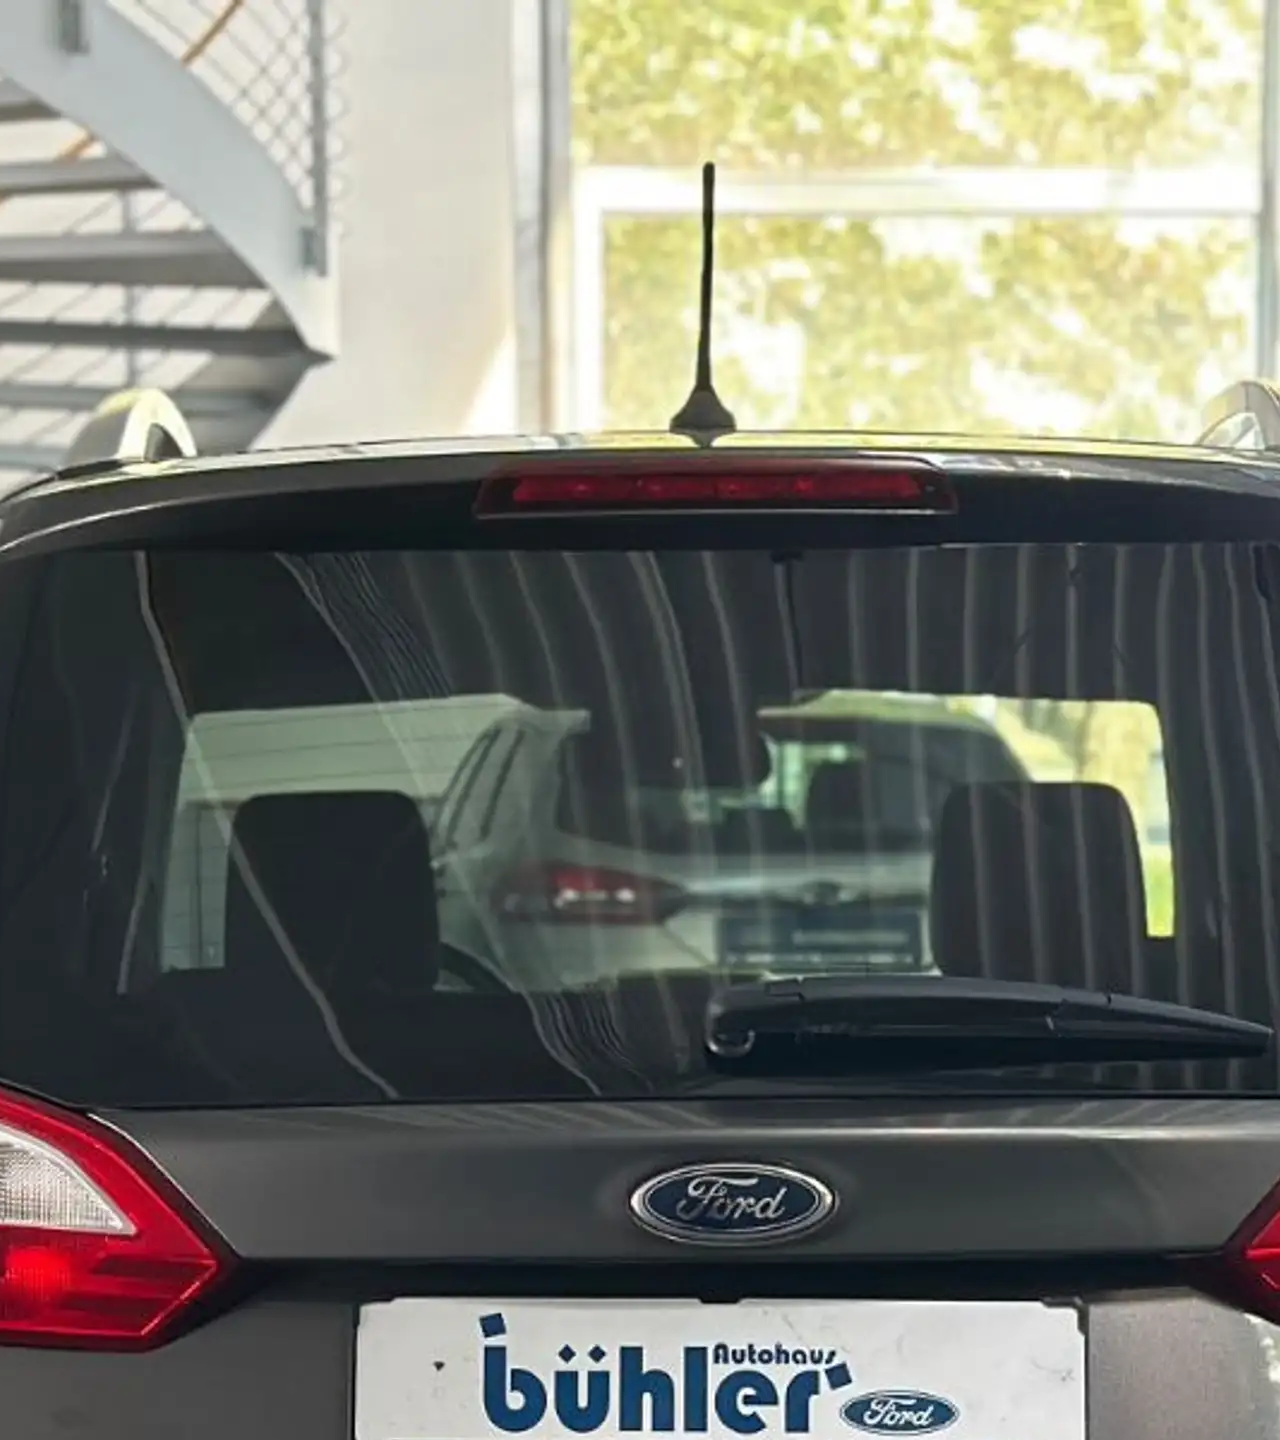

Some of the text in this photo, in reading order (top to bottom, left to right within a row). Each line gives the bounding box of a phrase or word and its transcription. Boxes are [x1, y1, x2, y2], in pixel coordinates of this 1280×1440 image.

[675, 1175, 788, 1221] Ford
[479, 1312, 853, 1434] bühler
[713, 1342, 836, 1366] Autohaus
[862, 1397, 934, 1428] Ford
